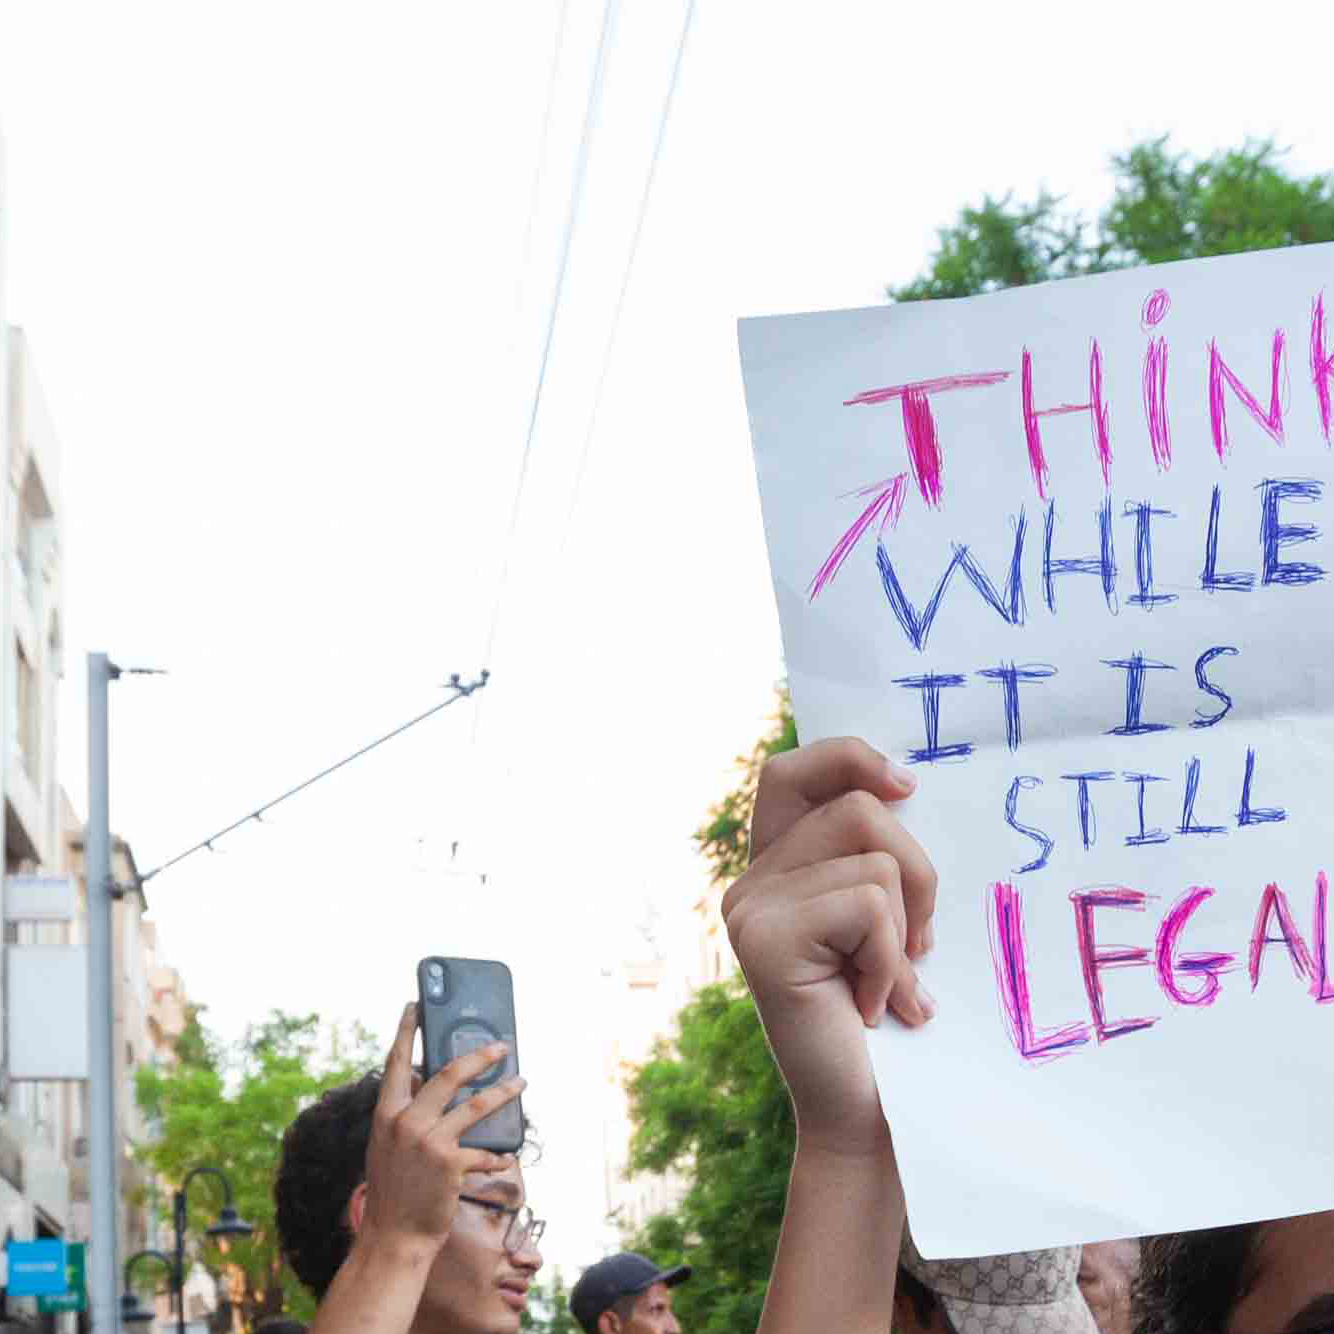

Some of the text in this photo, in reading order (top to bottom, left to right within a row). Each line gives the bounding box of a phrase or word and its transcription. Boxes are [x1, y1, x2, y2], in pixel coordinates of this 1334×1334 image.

[876, 477, 1325, 652] WHILE
[891, 644, 1239, 764] IT IS
[1002, 745, 1286, 875] STILL
